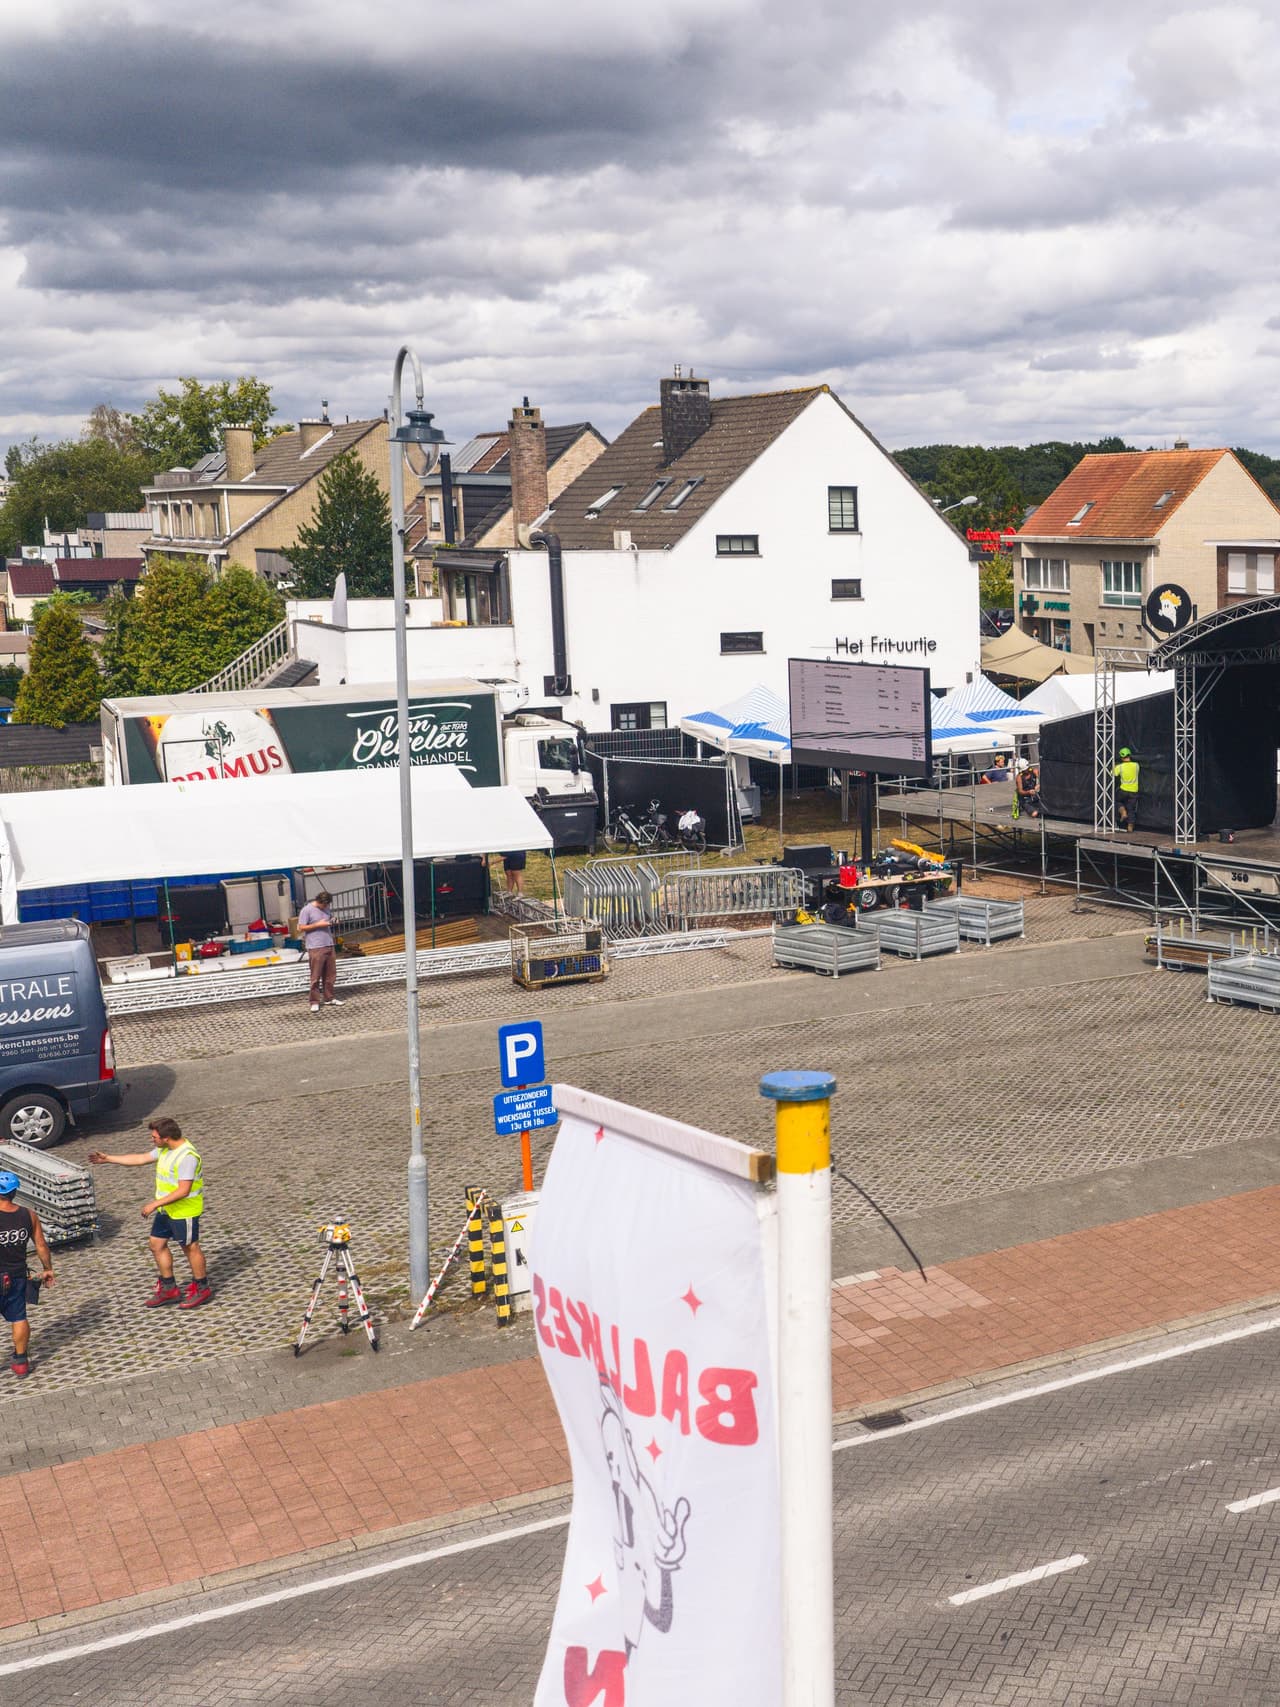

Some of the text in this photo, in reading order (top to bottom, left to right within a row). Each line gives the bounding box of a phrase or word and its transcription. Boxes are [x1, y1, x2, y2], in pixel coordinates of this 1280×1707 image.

[835, 635, 937, 657] Het Frit-uurtje
[1231, 872, 1249, 883] 360
[506, 1032, 537, 1078] P
[503, 1089, 548, 1104] UITGEZONDERD
[515, 1100, 537, 1111] MARKT
[497, 1106, 556, 1124] WOENSDAG TUSSEN
[523, 1120, 532, 1129] EN
[0, 1228, 28, 1245] 360
